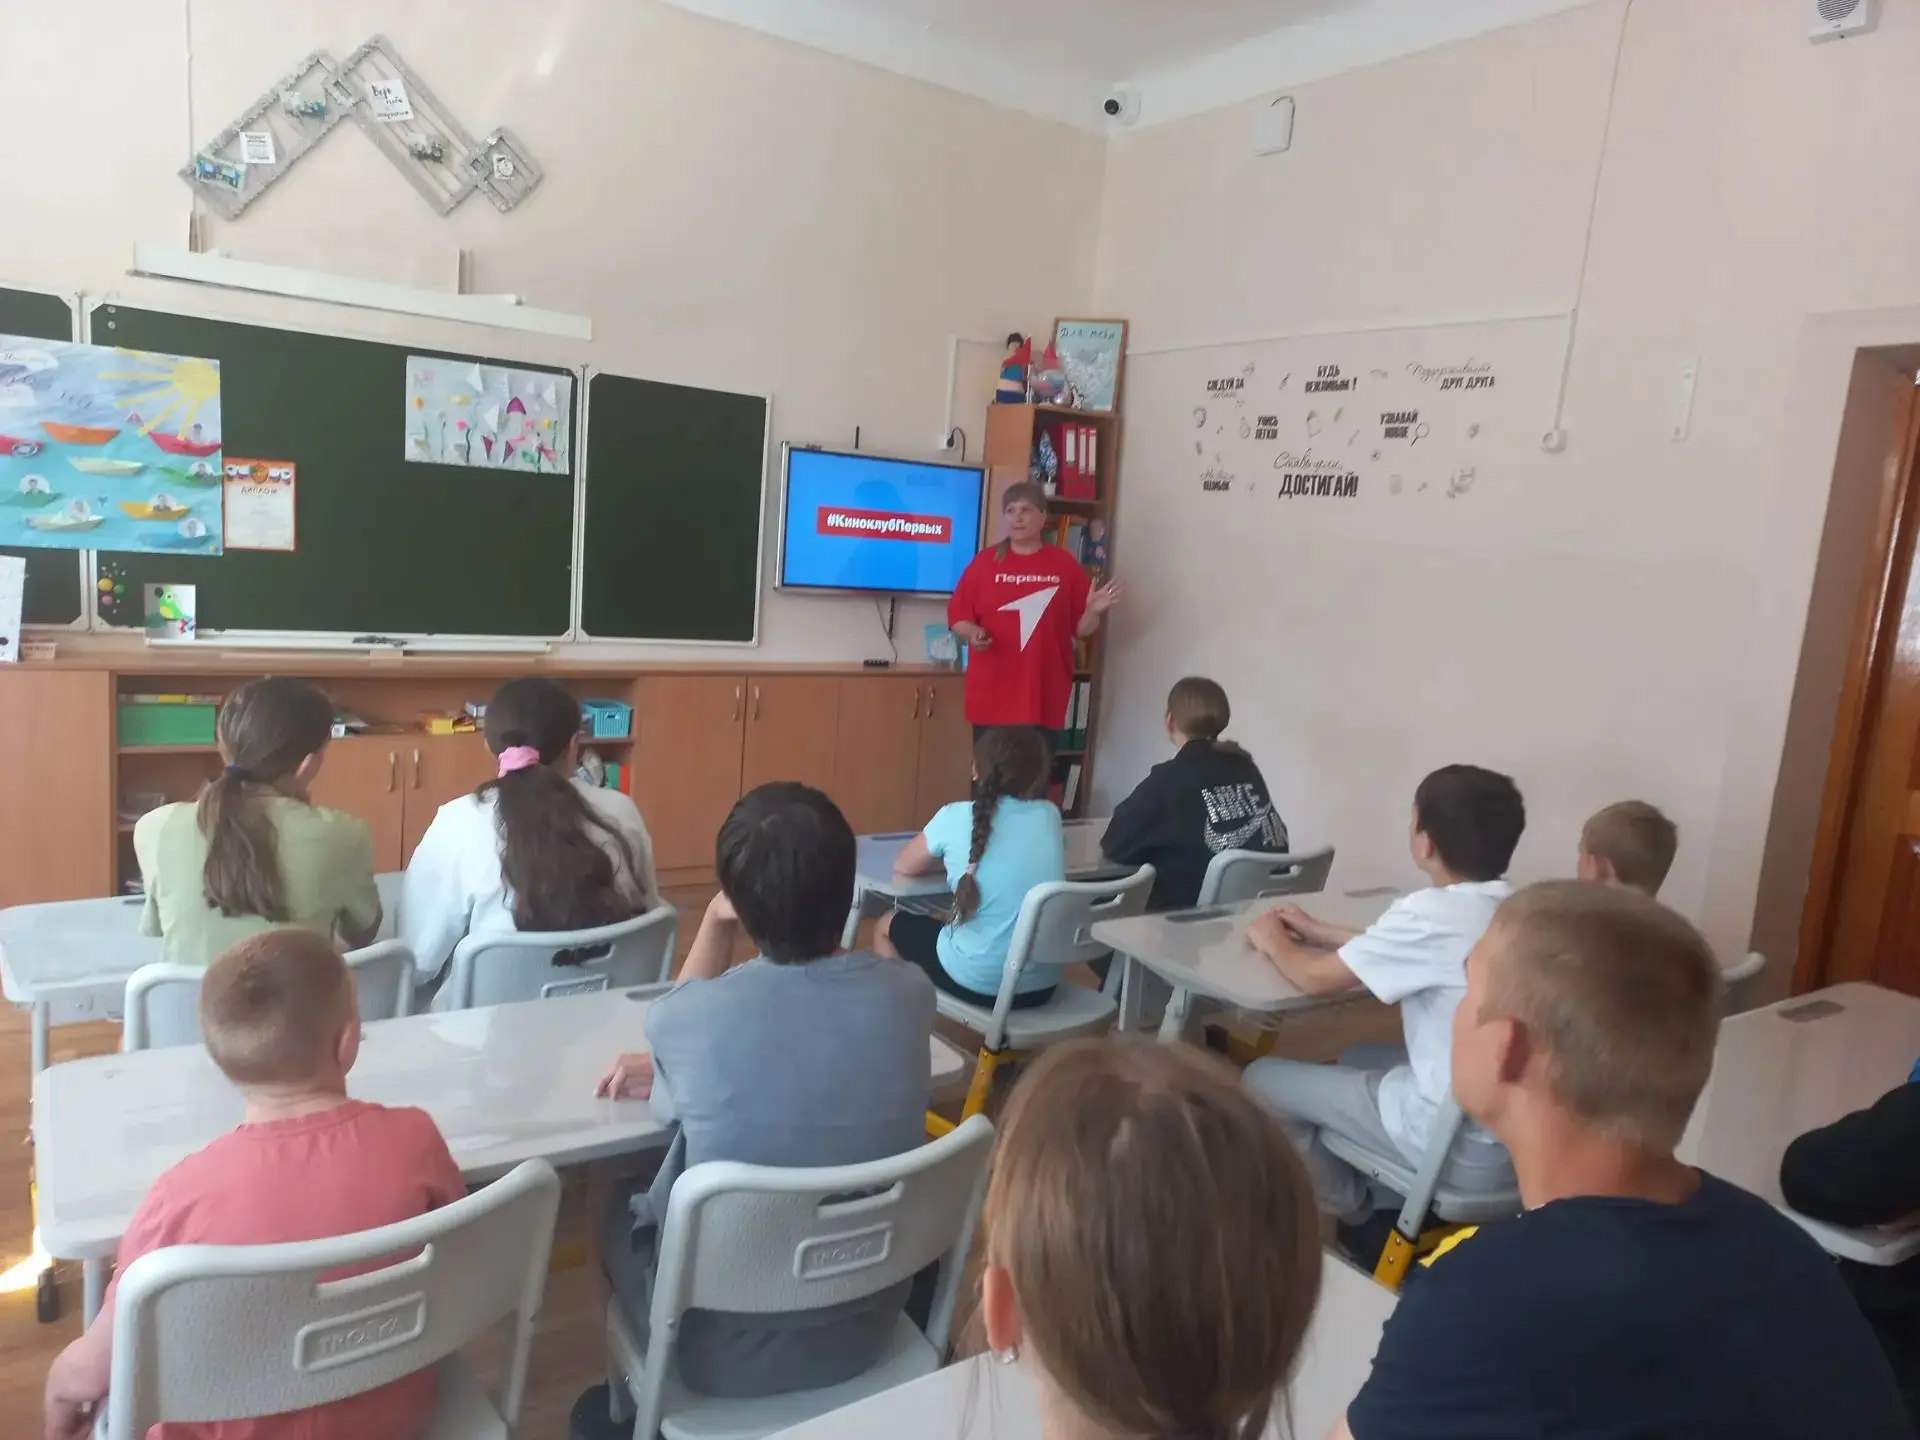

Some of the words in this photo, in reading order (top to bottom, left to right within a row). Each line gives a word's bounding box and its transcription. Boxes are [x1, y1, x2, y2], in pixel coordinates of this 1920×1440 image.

[1317, 365, 1340, 378] БУДЬ
[1440, 376, 1464, 391] ДРУГ
[1465, 376, 1495, 390] ДРУГА
[1278, 472, 1359, 499] ДОСТИГАЙ!
[827, 513, 943, 536] #КиноклубПервых
[995, 573, 1060, 585] Первые
